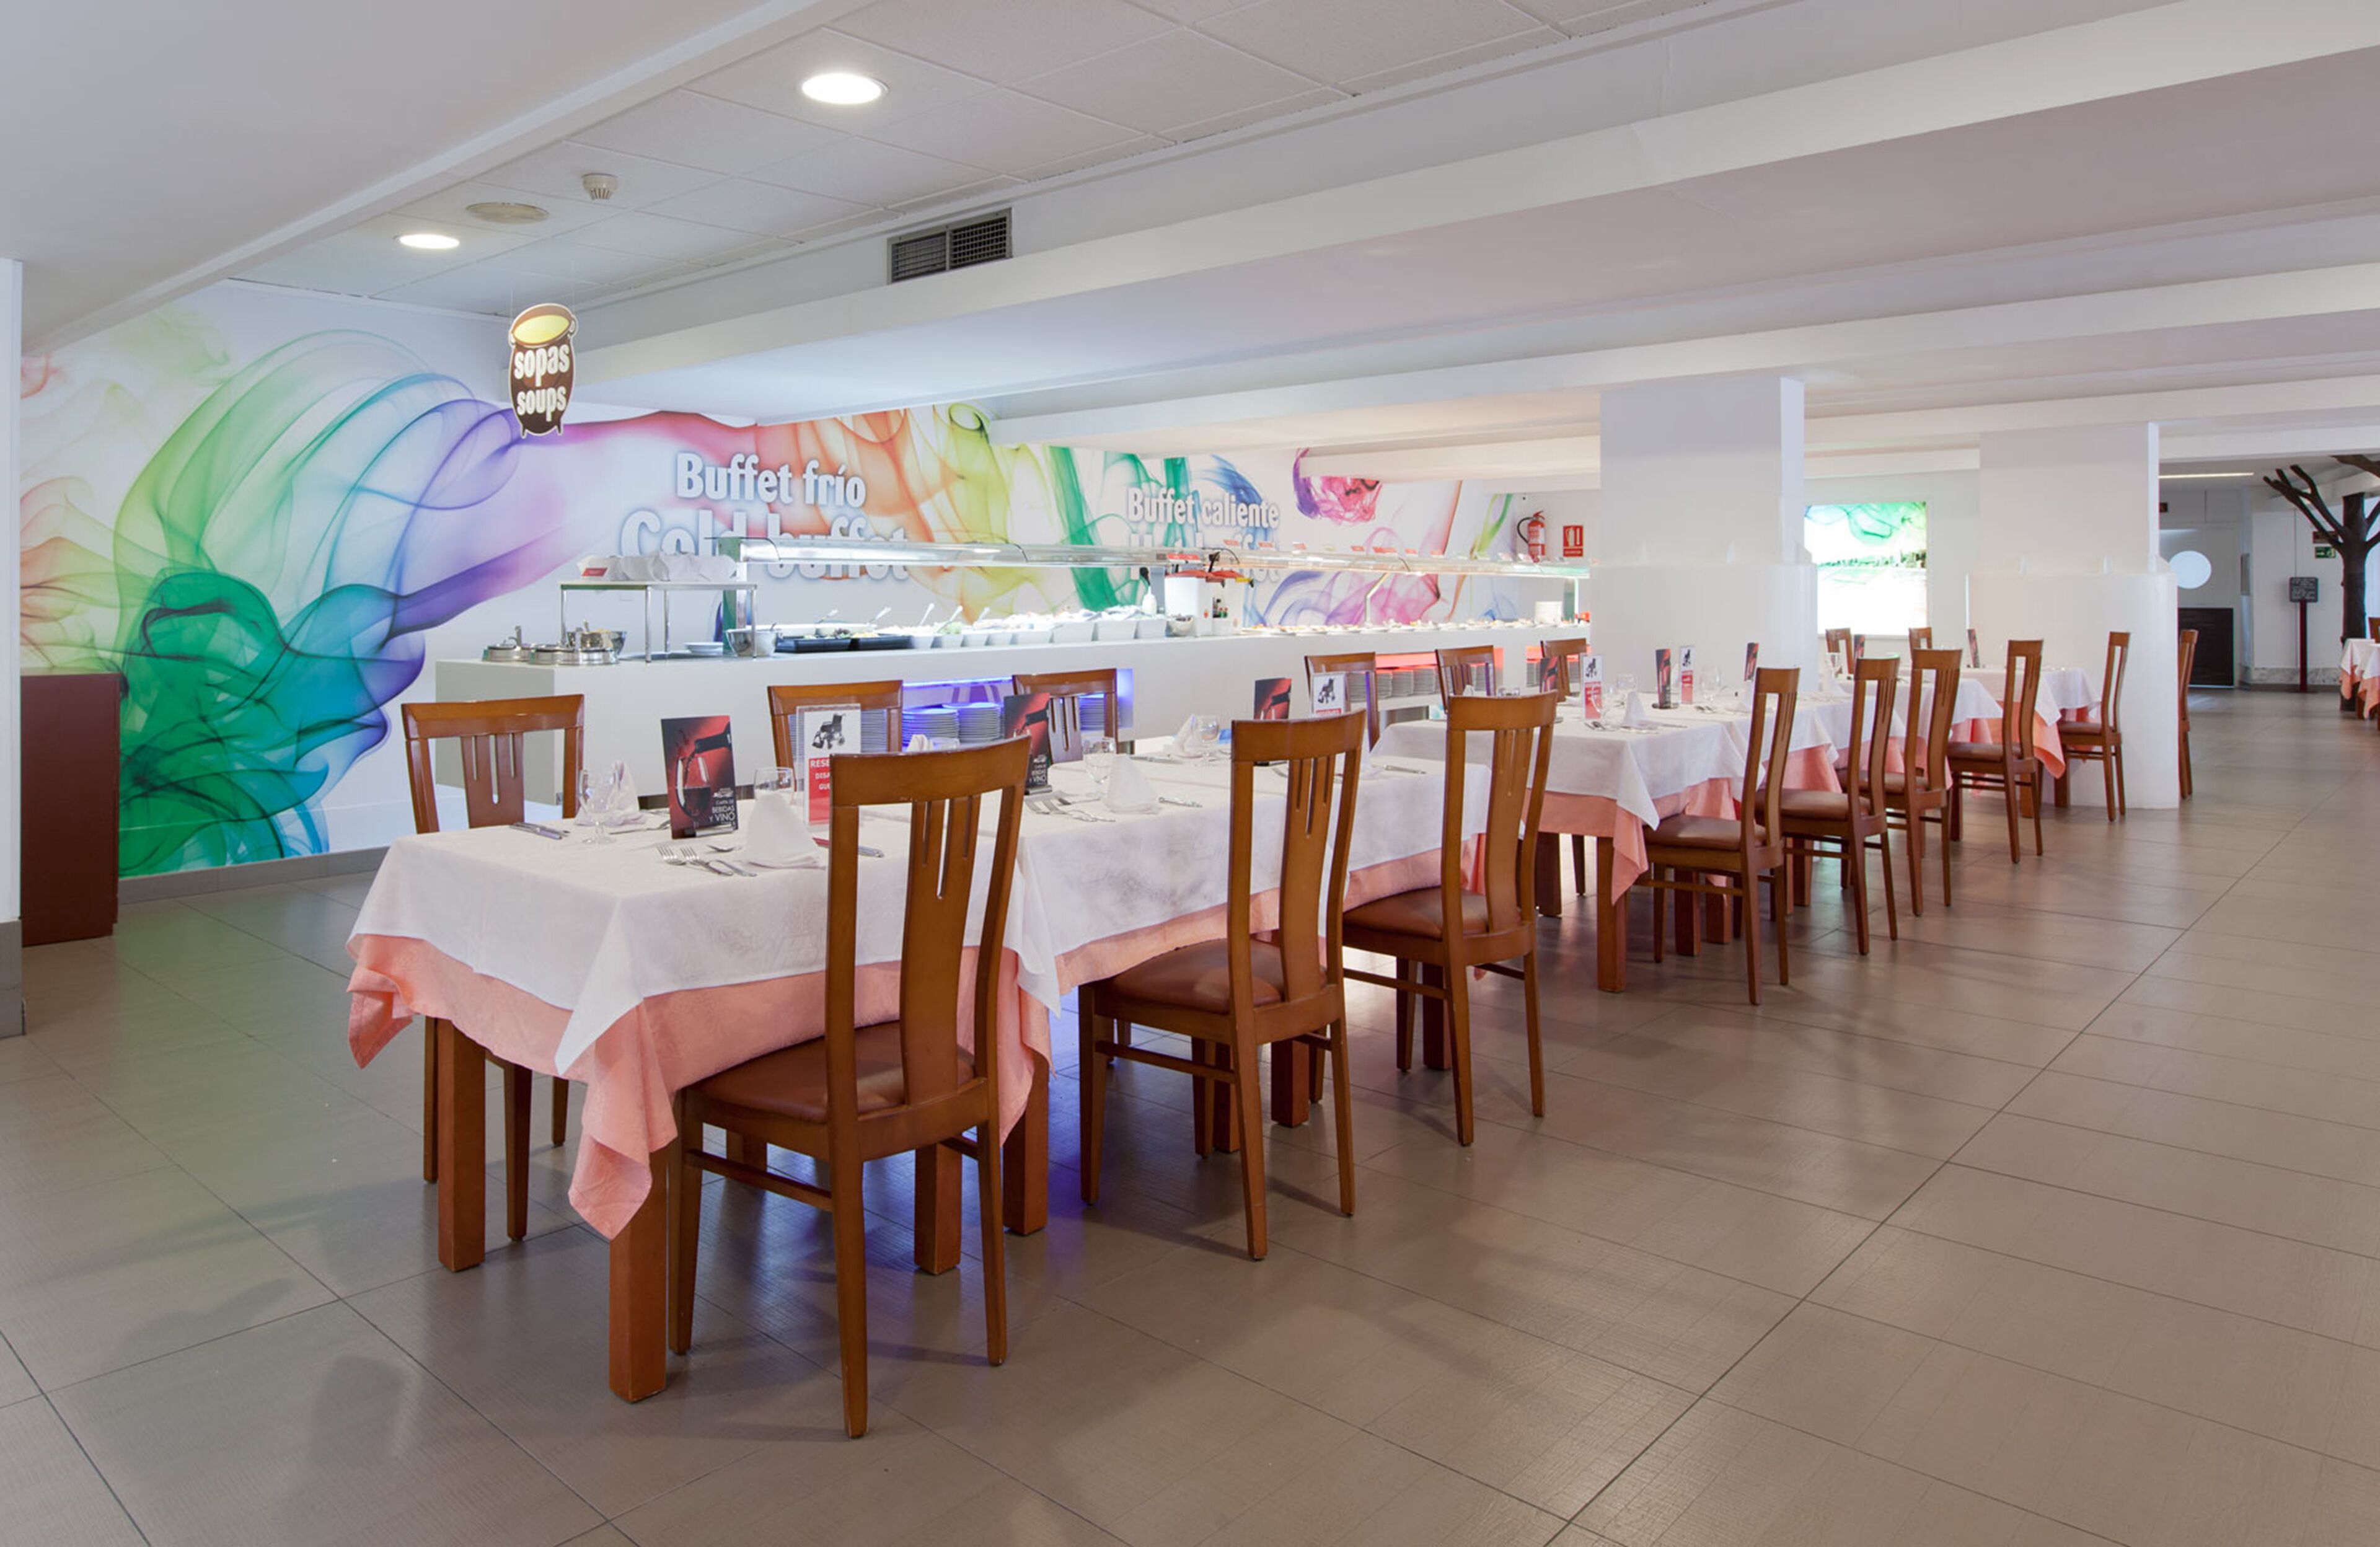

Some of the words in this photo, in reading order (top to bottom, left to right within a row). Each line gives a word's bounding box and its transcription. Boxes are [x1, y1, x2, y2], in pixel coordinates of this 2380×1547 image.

[514, 344, 570, 387] sopas
[516, 386, 566, 422] soups
[676, 452, 792, 503] Buffet
[803, 459, 866, 508] frío
[1129, 487, 1195, 524] Buffet
[1202, 494, 1279, 527] caliente
[715, 811, 736, 822] VINO
